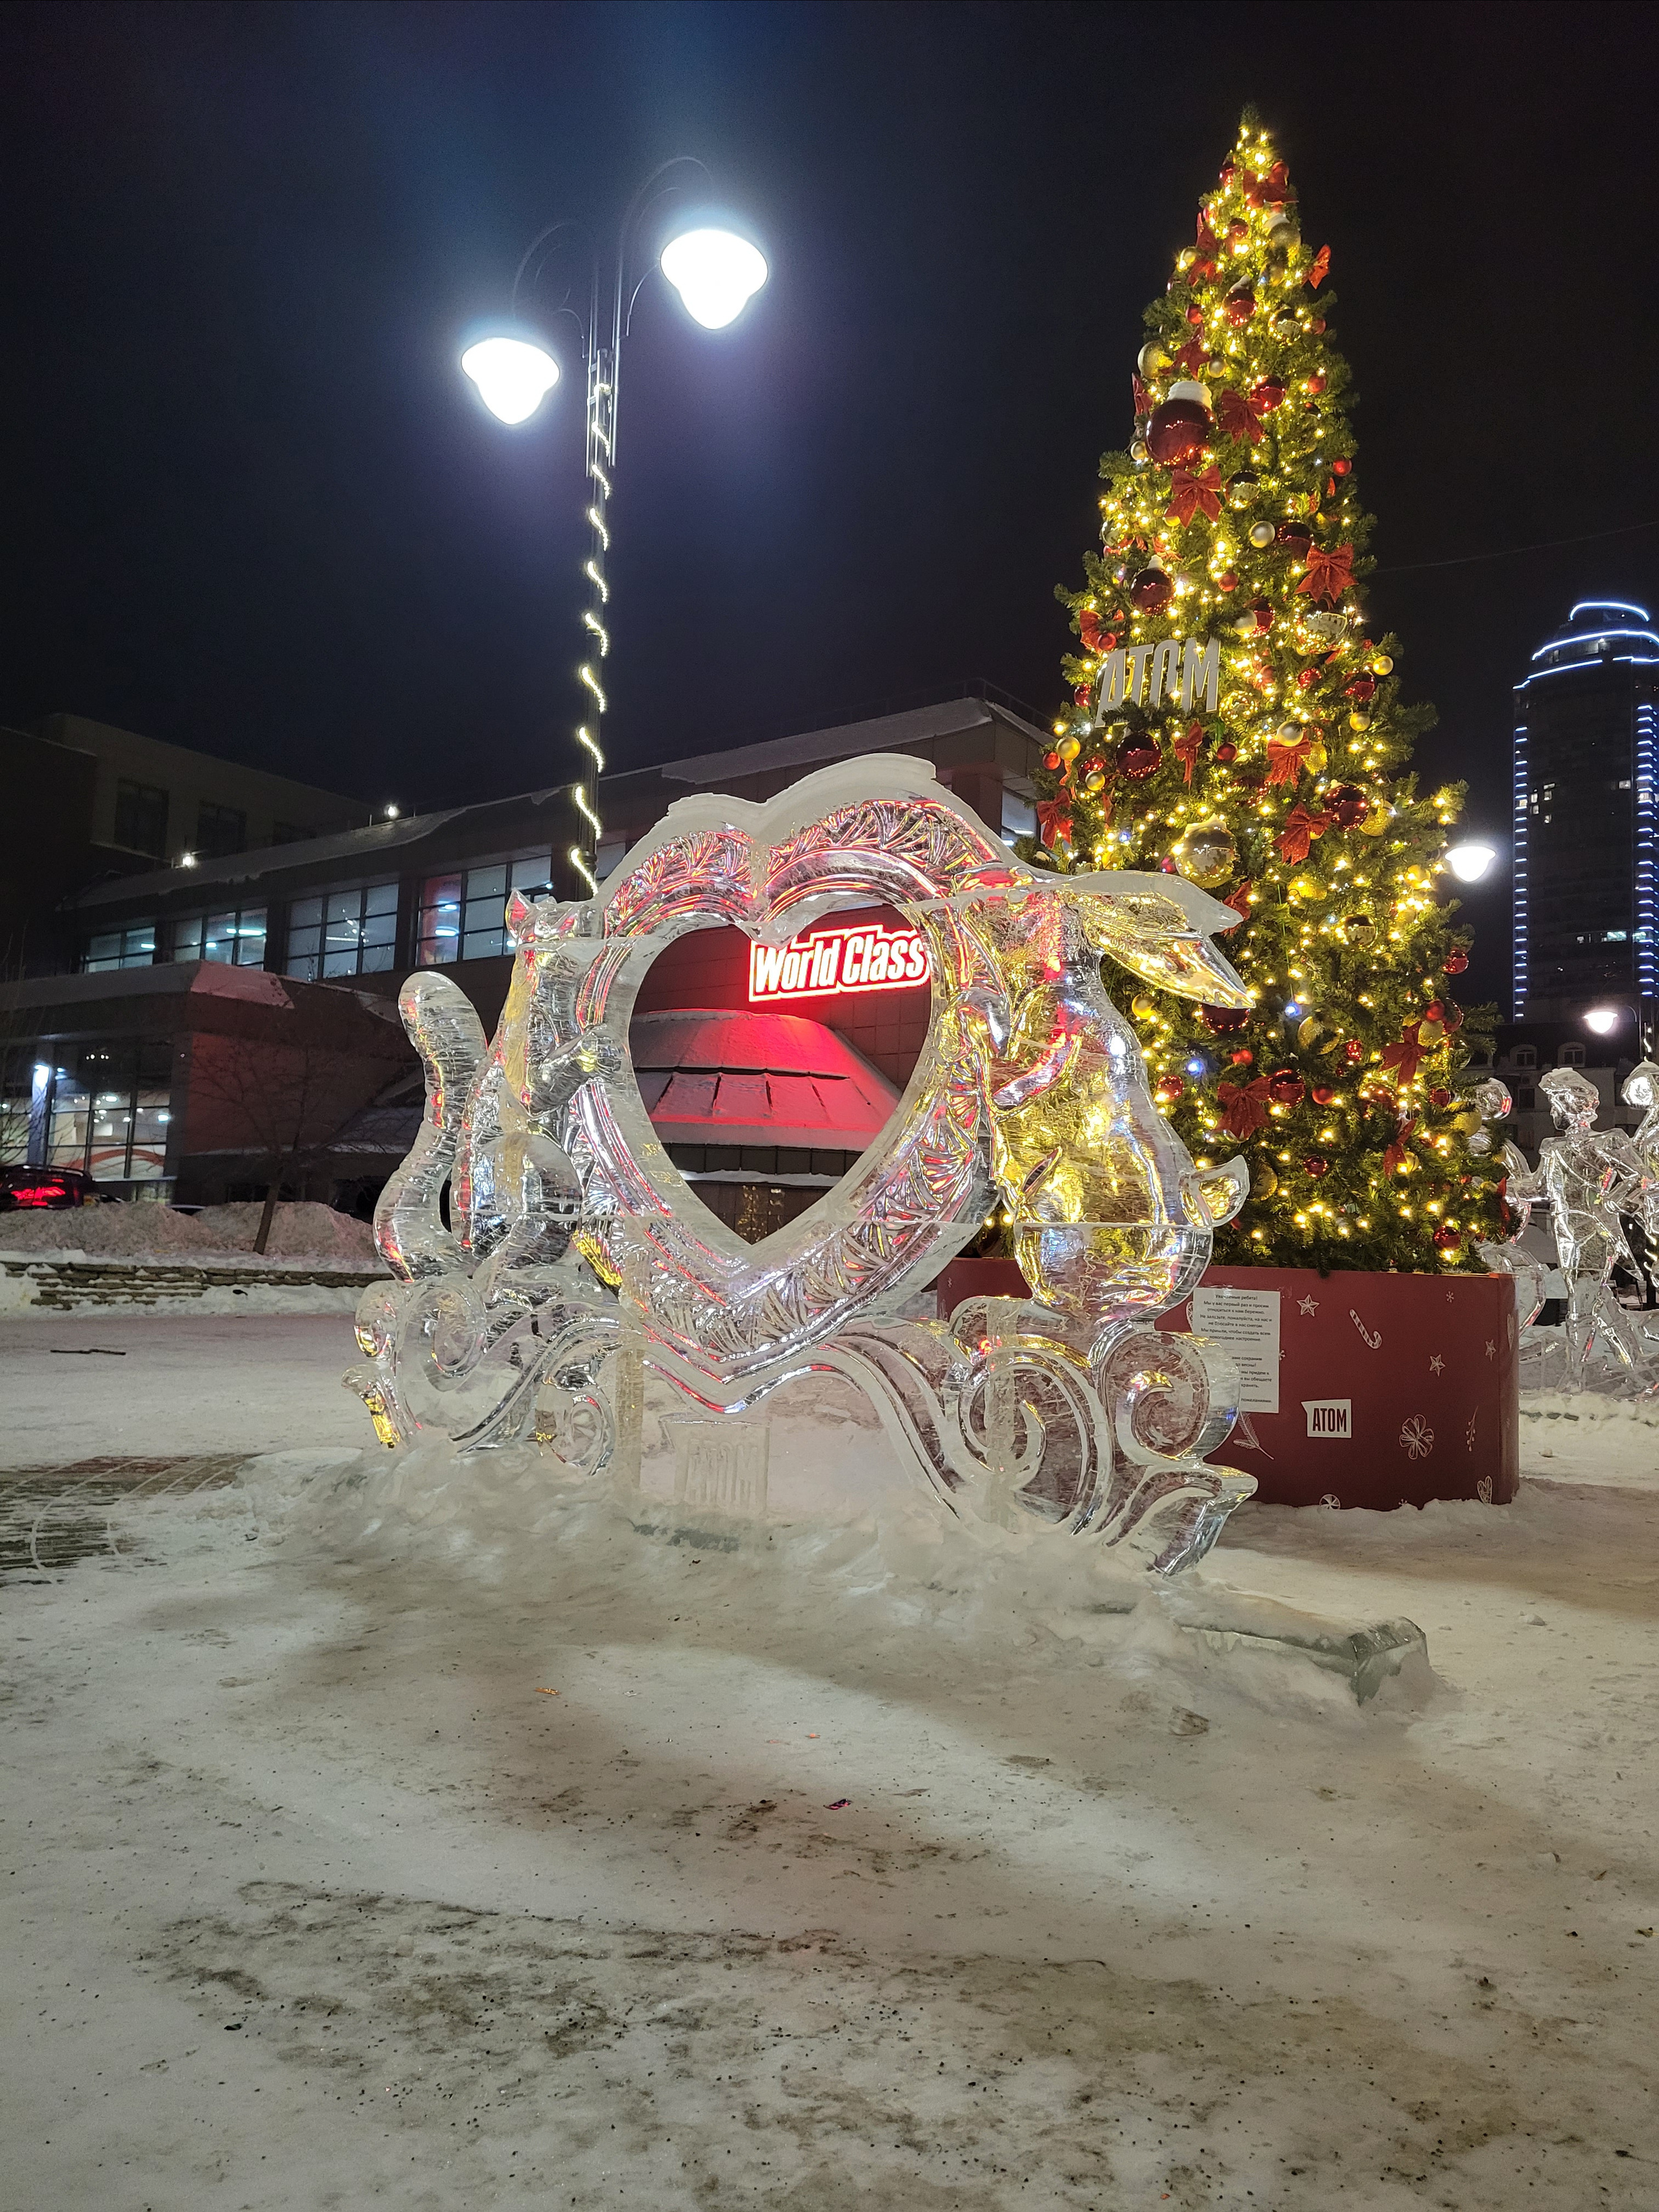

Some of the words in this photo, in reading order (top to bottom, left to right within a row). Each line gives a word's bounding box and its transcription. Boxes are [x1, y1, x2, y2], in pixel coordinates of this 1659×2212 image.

[754, 938, 841, 993] World
[841, 934, 925, 984] Class
[1312, 1408, 1347, 1432] АТОМ
